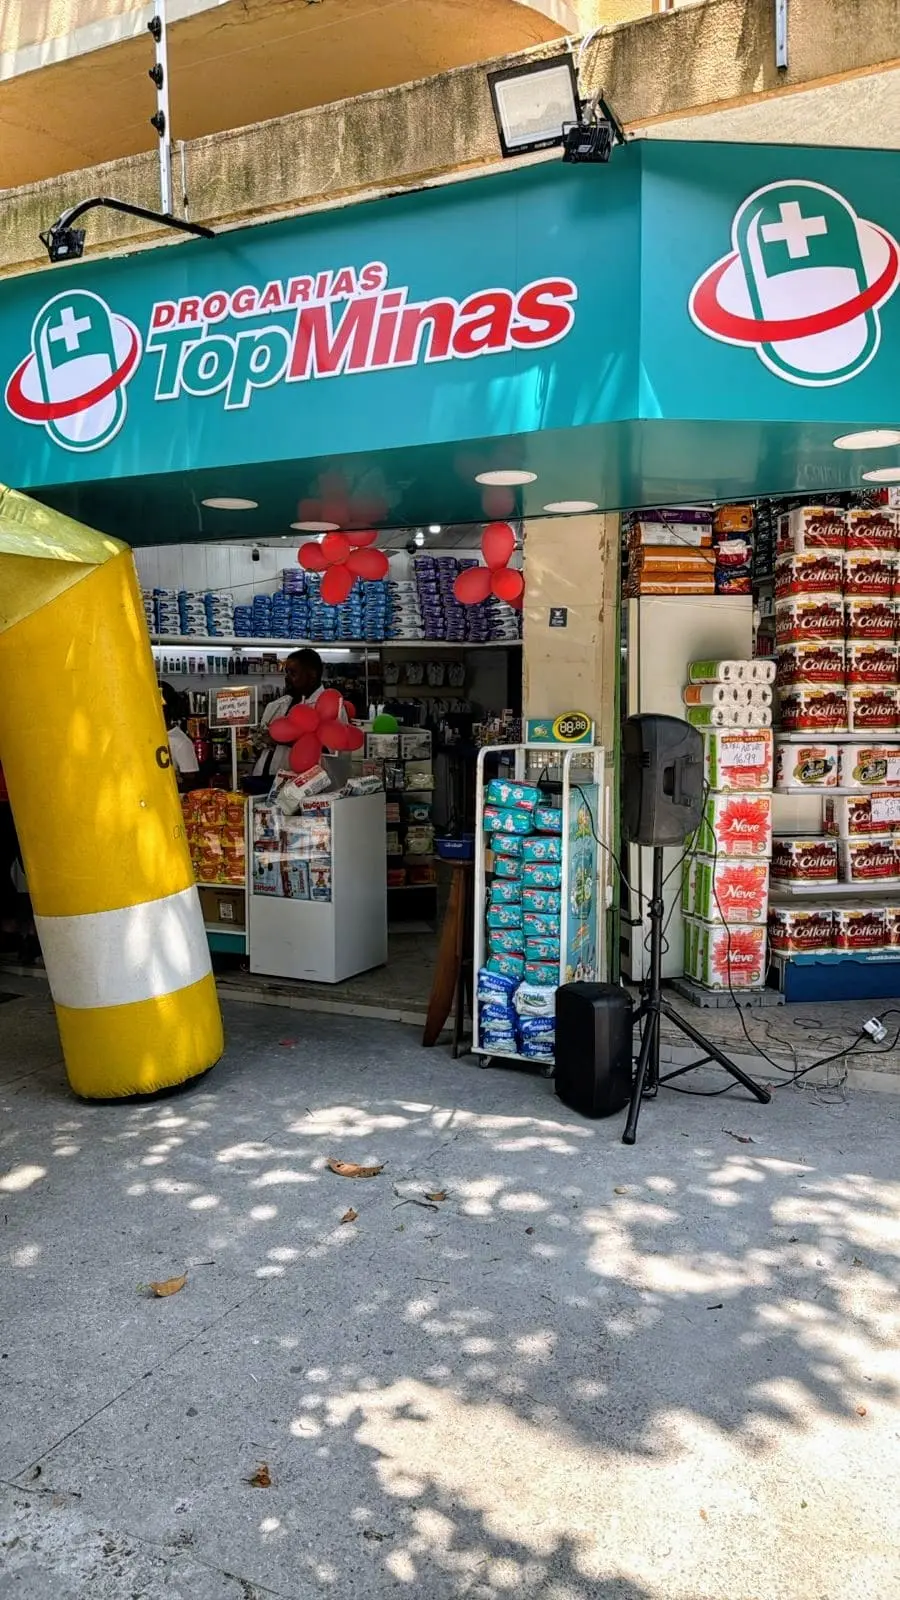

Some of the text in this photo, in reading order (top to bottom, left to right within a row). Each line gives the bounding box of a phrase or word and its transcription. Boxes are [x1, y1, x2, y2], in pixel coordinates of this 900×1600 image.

[151, 262, 386, 329] DROGARIAS
[147, 277, 577, 410] TopMinas
[728, 818, 760, 833] Neve
[721, 884, 757, 899] Neve
[721, 949, 754, 963] Neve
